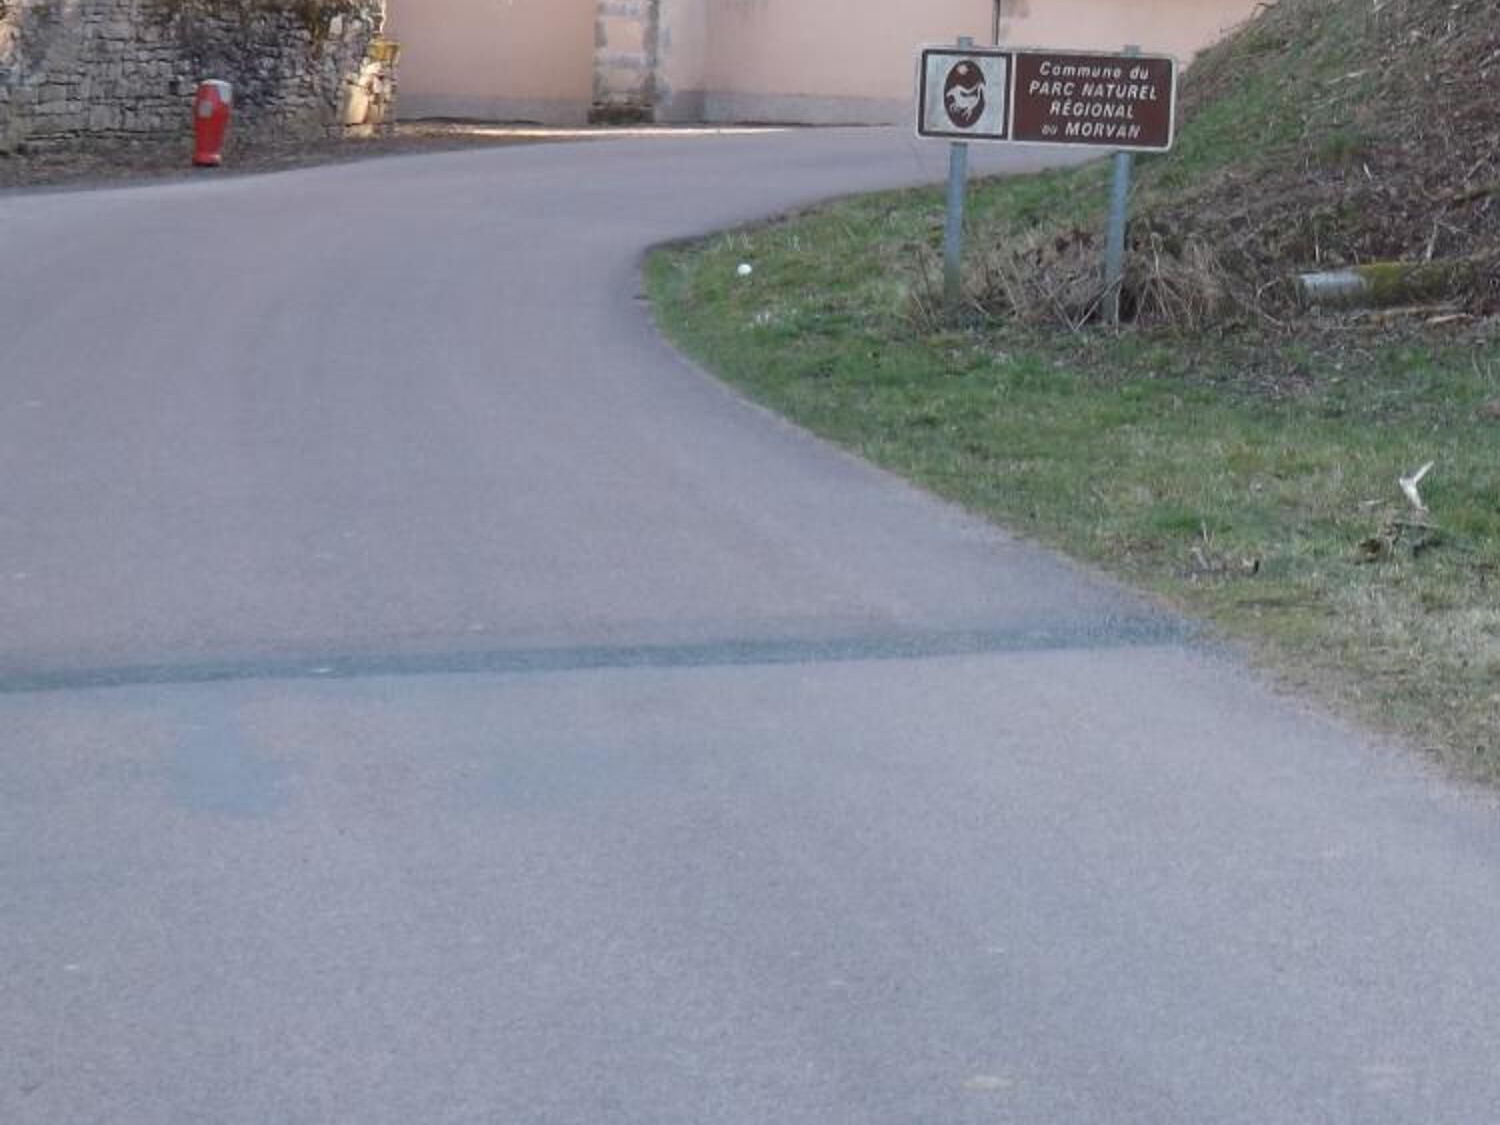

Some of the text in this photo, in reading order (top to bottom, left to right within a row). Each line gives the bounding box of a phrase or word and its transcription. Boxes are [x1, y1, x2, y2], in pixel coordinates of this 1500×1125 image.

[1039, 61, 1149, 80] Commune du
[1029, 80, 1157, 100] PARC NATUREL
[1049, 99, 1134, 119] RÉGIONAL
[1065, 122, 1141, 138] MORVAN
